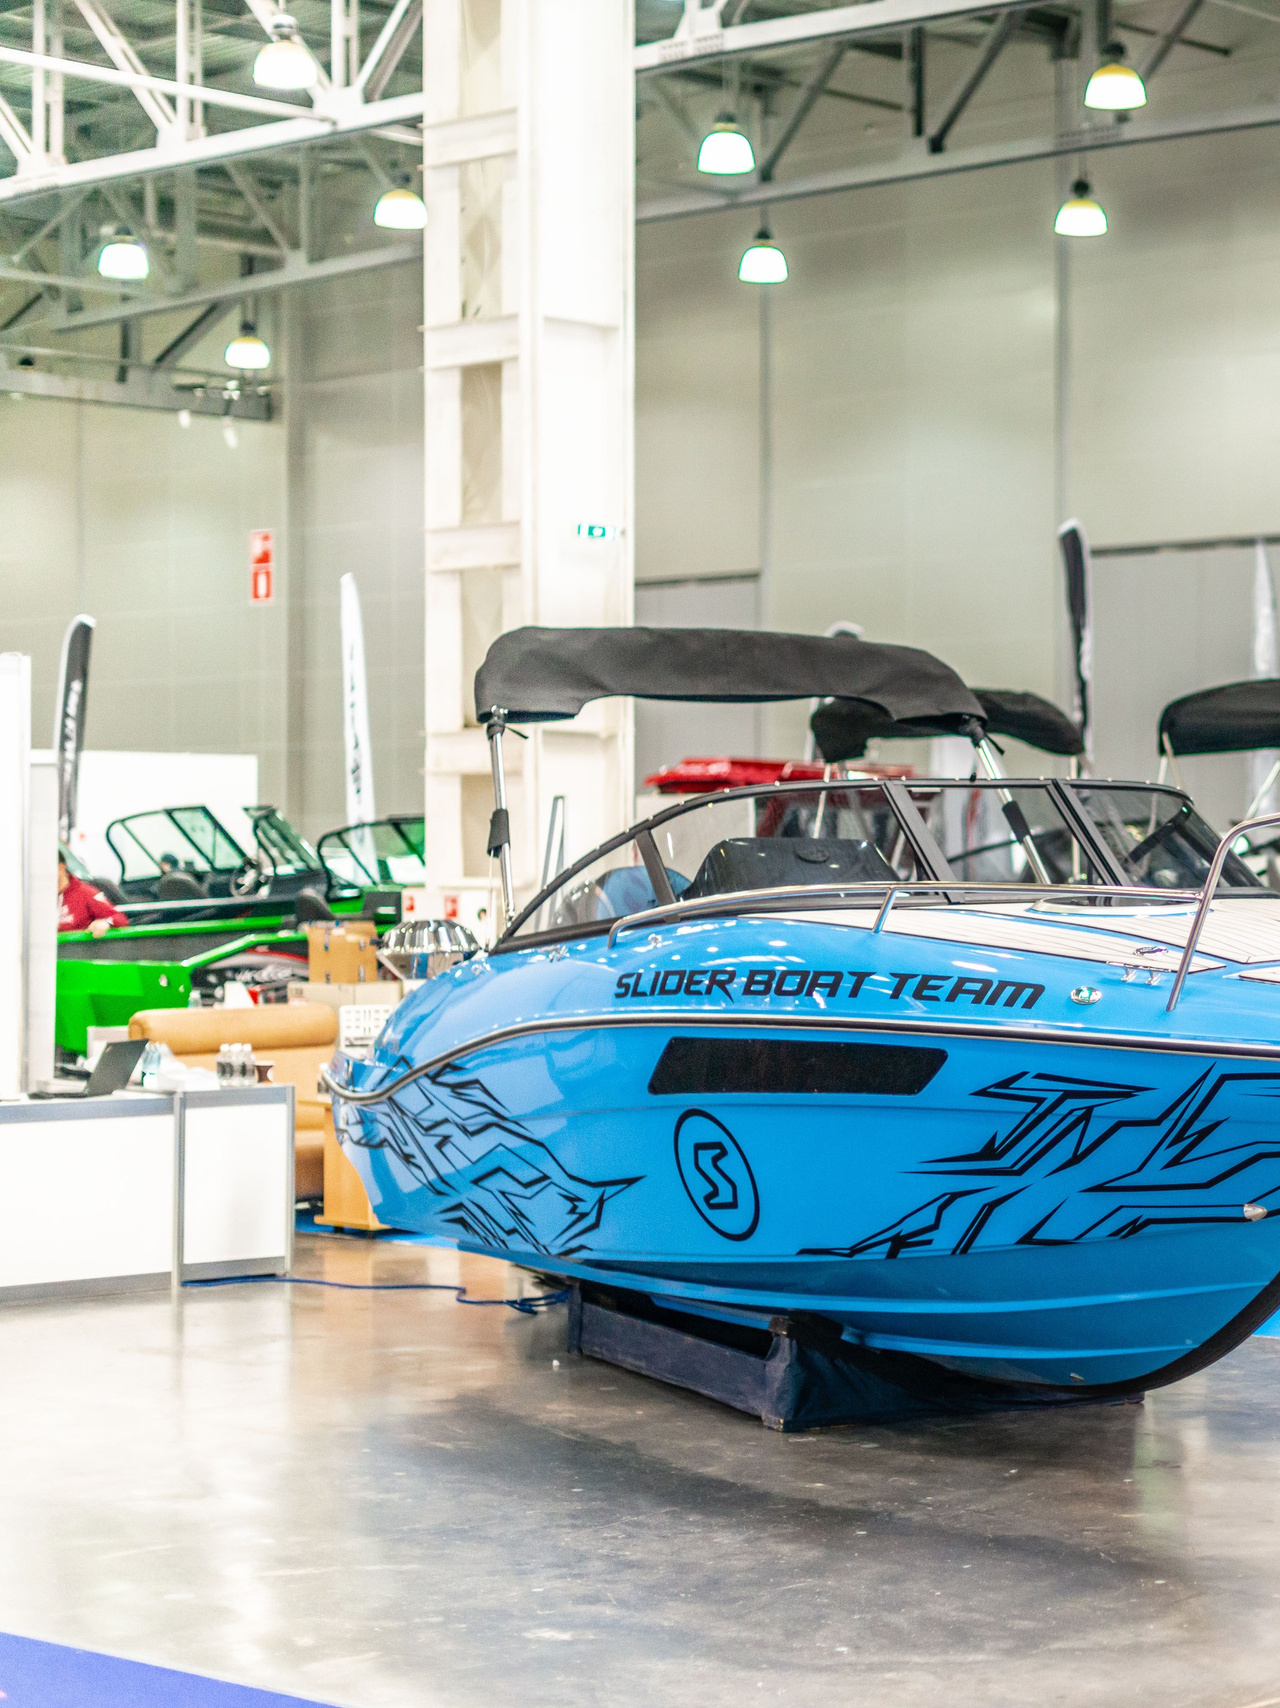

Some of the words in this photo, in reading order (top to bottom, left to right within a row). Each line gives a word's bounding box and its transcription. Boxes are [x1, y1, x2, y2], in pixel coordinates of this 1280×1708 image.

[615, 969, 737, 1002] SLIDER
[742, 969, 877, 998] BOAT
[888, 972, 1046, 1010] TEAM
